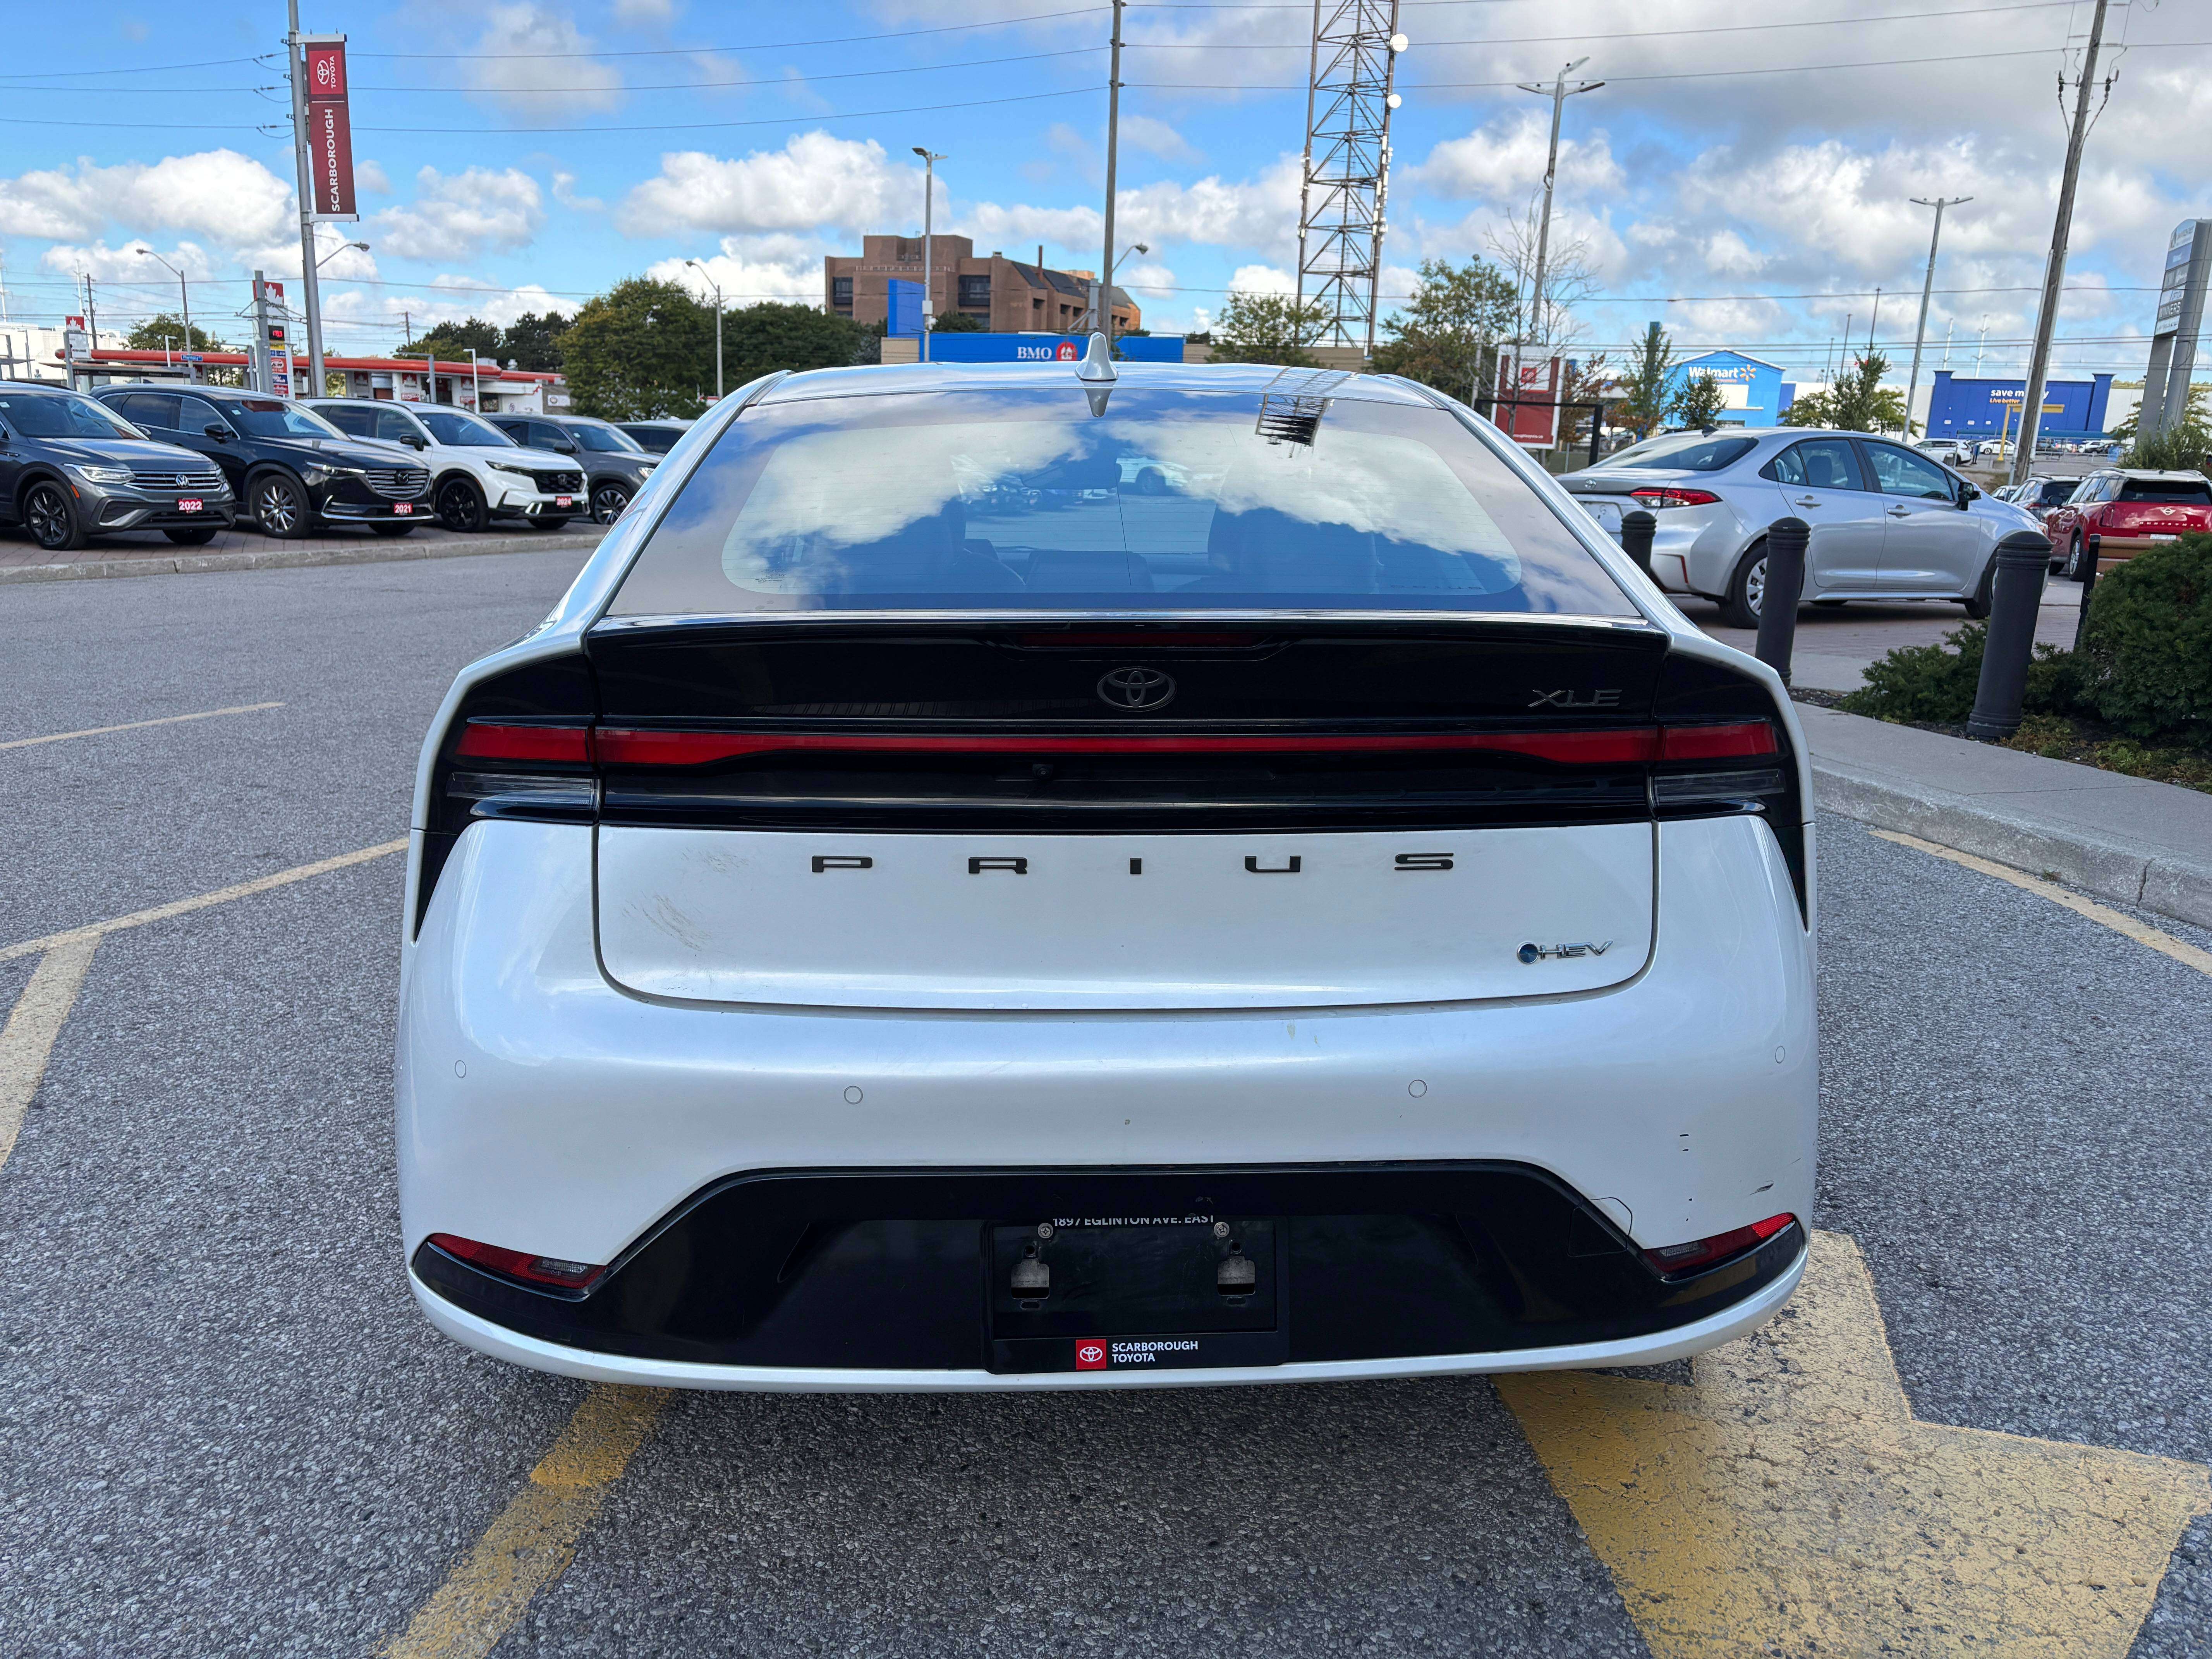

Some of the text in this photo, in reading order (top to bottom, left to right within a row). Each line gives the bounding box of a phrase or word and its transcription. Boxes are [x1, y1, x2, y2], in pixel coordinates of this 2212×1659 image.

[324, 109, 340, 212] SCARBOROUGH
[1017, 347, 1052, 359] BMO
[1688, 366, 1738, 378] Walmart
[179, 501, 203, 510] 2022
[395, 504, 411, 514] 2021
[1528, 689, 1622, 707] XLE
[811, 853, 1455, 874] PRIUS
[1539, 940, 1613, 959] HEV
[1112, 1341, 1198, 1352] SCARBOROUGH
[1112, 1353, 1156, 1363] TOYOTA
